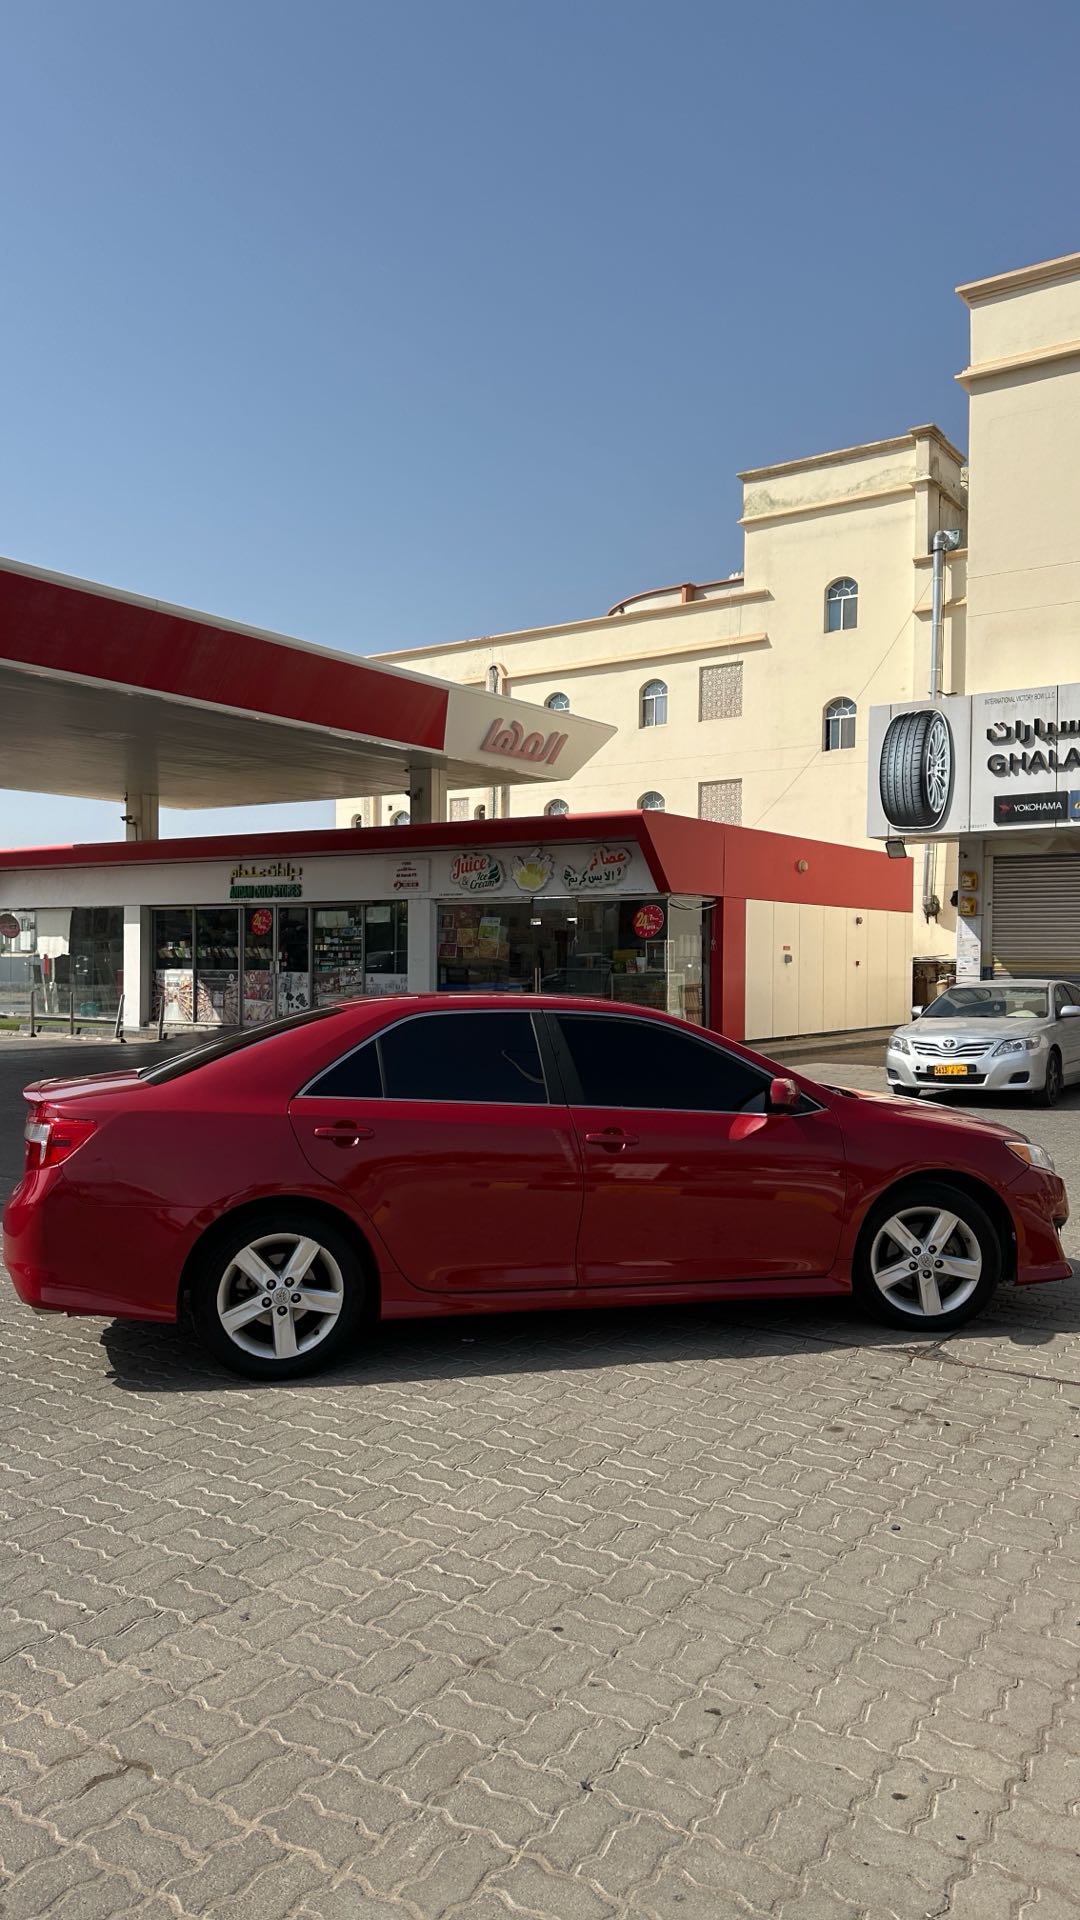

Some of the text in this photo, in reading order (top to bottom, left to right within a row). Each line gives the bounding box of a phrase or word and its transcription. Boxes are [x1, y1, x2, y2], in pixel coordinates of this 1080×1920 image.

[480, 717, 569, 765] المها
[987, 747, 1080, 776] GHALA
[1013, 801, 1063, 812] YOKOHAMA
[453, 857, 487, 880] Juice
[477, 872, 489, 881] Ice
[255, 885, 273, 898] COLD
[274, 884, 302, 898] STORES
[470, 880, 495, 890] Cream
[636, 911, 649, 930] 24
